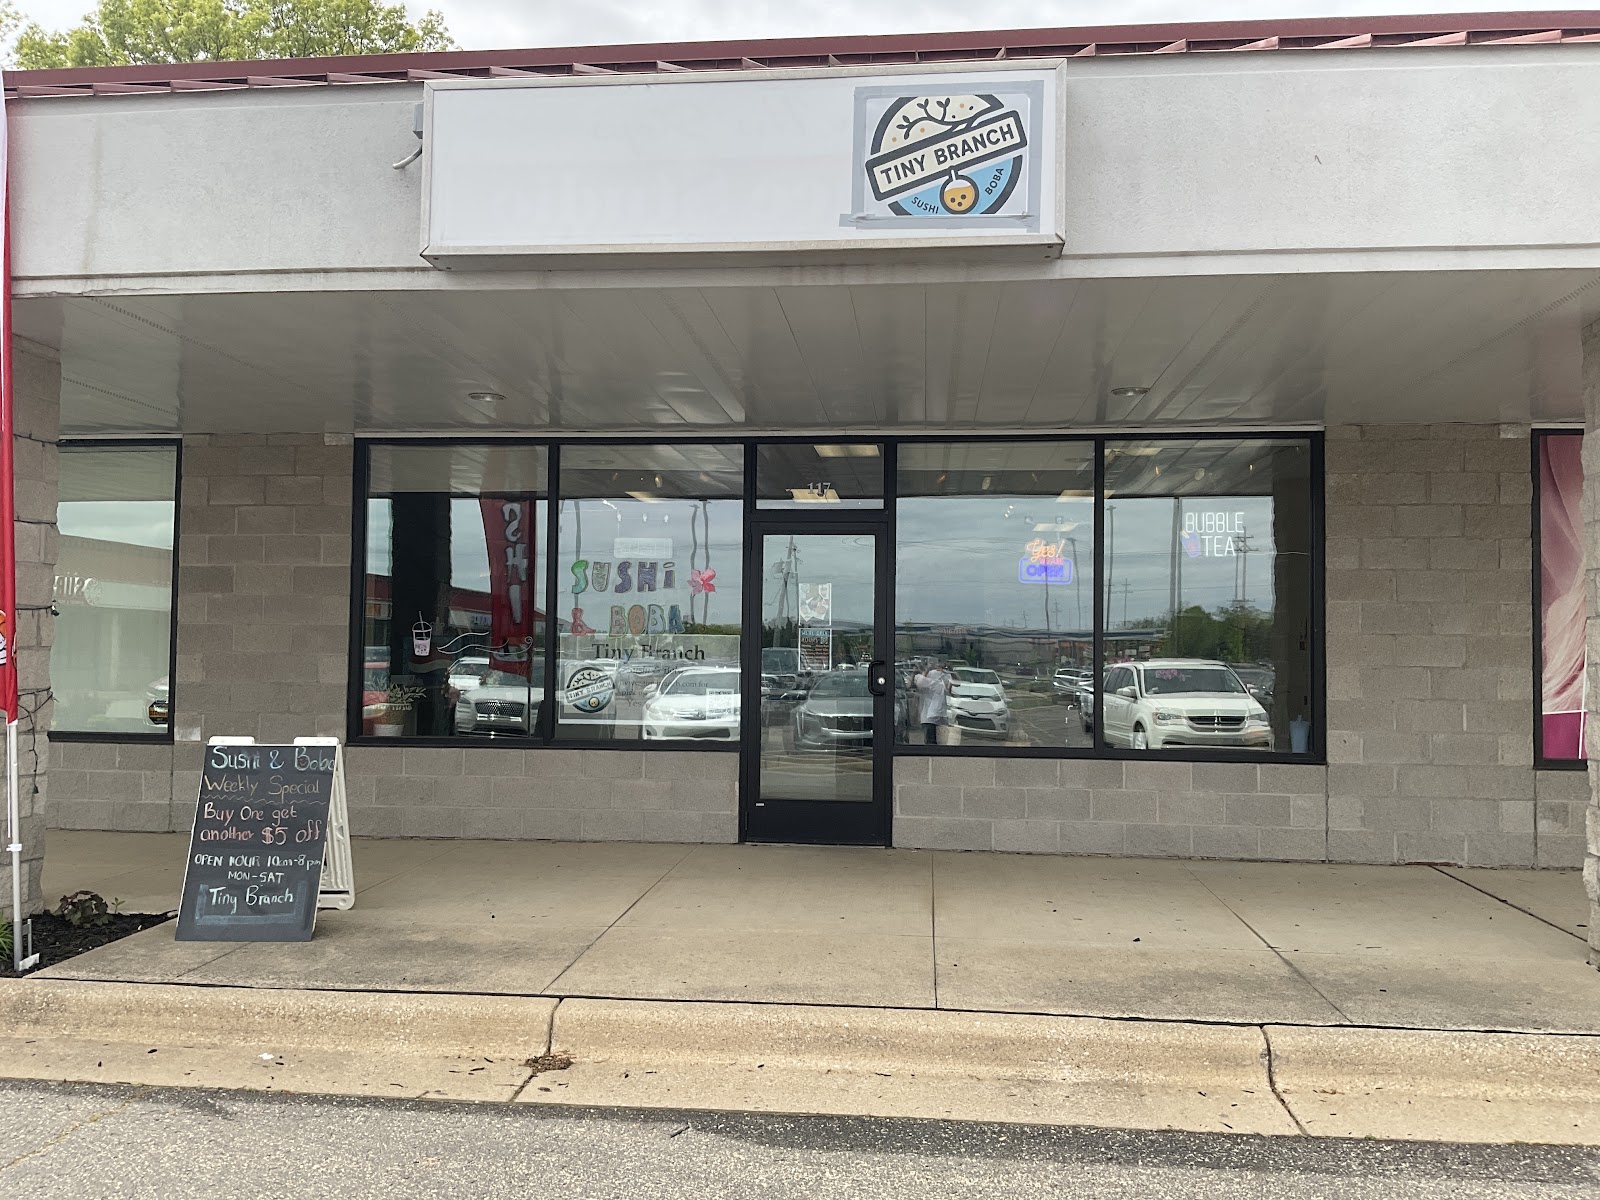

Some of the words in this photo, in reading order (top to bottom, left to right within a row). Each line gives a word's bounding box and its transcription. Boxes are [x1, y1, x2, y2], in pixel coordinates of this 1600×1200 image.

[880, 154, 926, 185] TINY
[934, 123, 1015, 166] BRANCH
[985, 168, 1004, 195] BOBA
[911, 196, 940, 214] SUSHI
[807, 482, 831, 496] 117
[1185, 512, 1245, 533] BUBBLE
[1201, 535, 1237, 557] TEA
[1026, 564, 1064, 578] OPEN
[571, 607, 597, 636] &
[609, 604, 685, 638] BOBA
[591, 643, 634, 664] Tiny
[640, 644, 706, 660] Branch
[569, 690, 584, 699] TINY
[586, 682, 612, 694] BRANCH
[211, 746, 260, 769] Sushi
[269, 750, 285, 769] &
[204, 774, 259, 796] Weekly
[268, 775, 320, 804] Special
[204, 802, 234, 826] Buy
[240, 806, 264, 821] One
[272, 805, 298, 827] get
[200, 826, 255, 841] another
[261, 826, 288, 845] $5
[295, 820, 322, 843] off
[194, 853, 224, 867] OPEN
[229, 855, 260, 867] HOUR
[209, 886, 237, 914] Tiny
[245, 885, 294, 905] Branch
